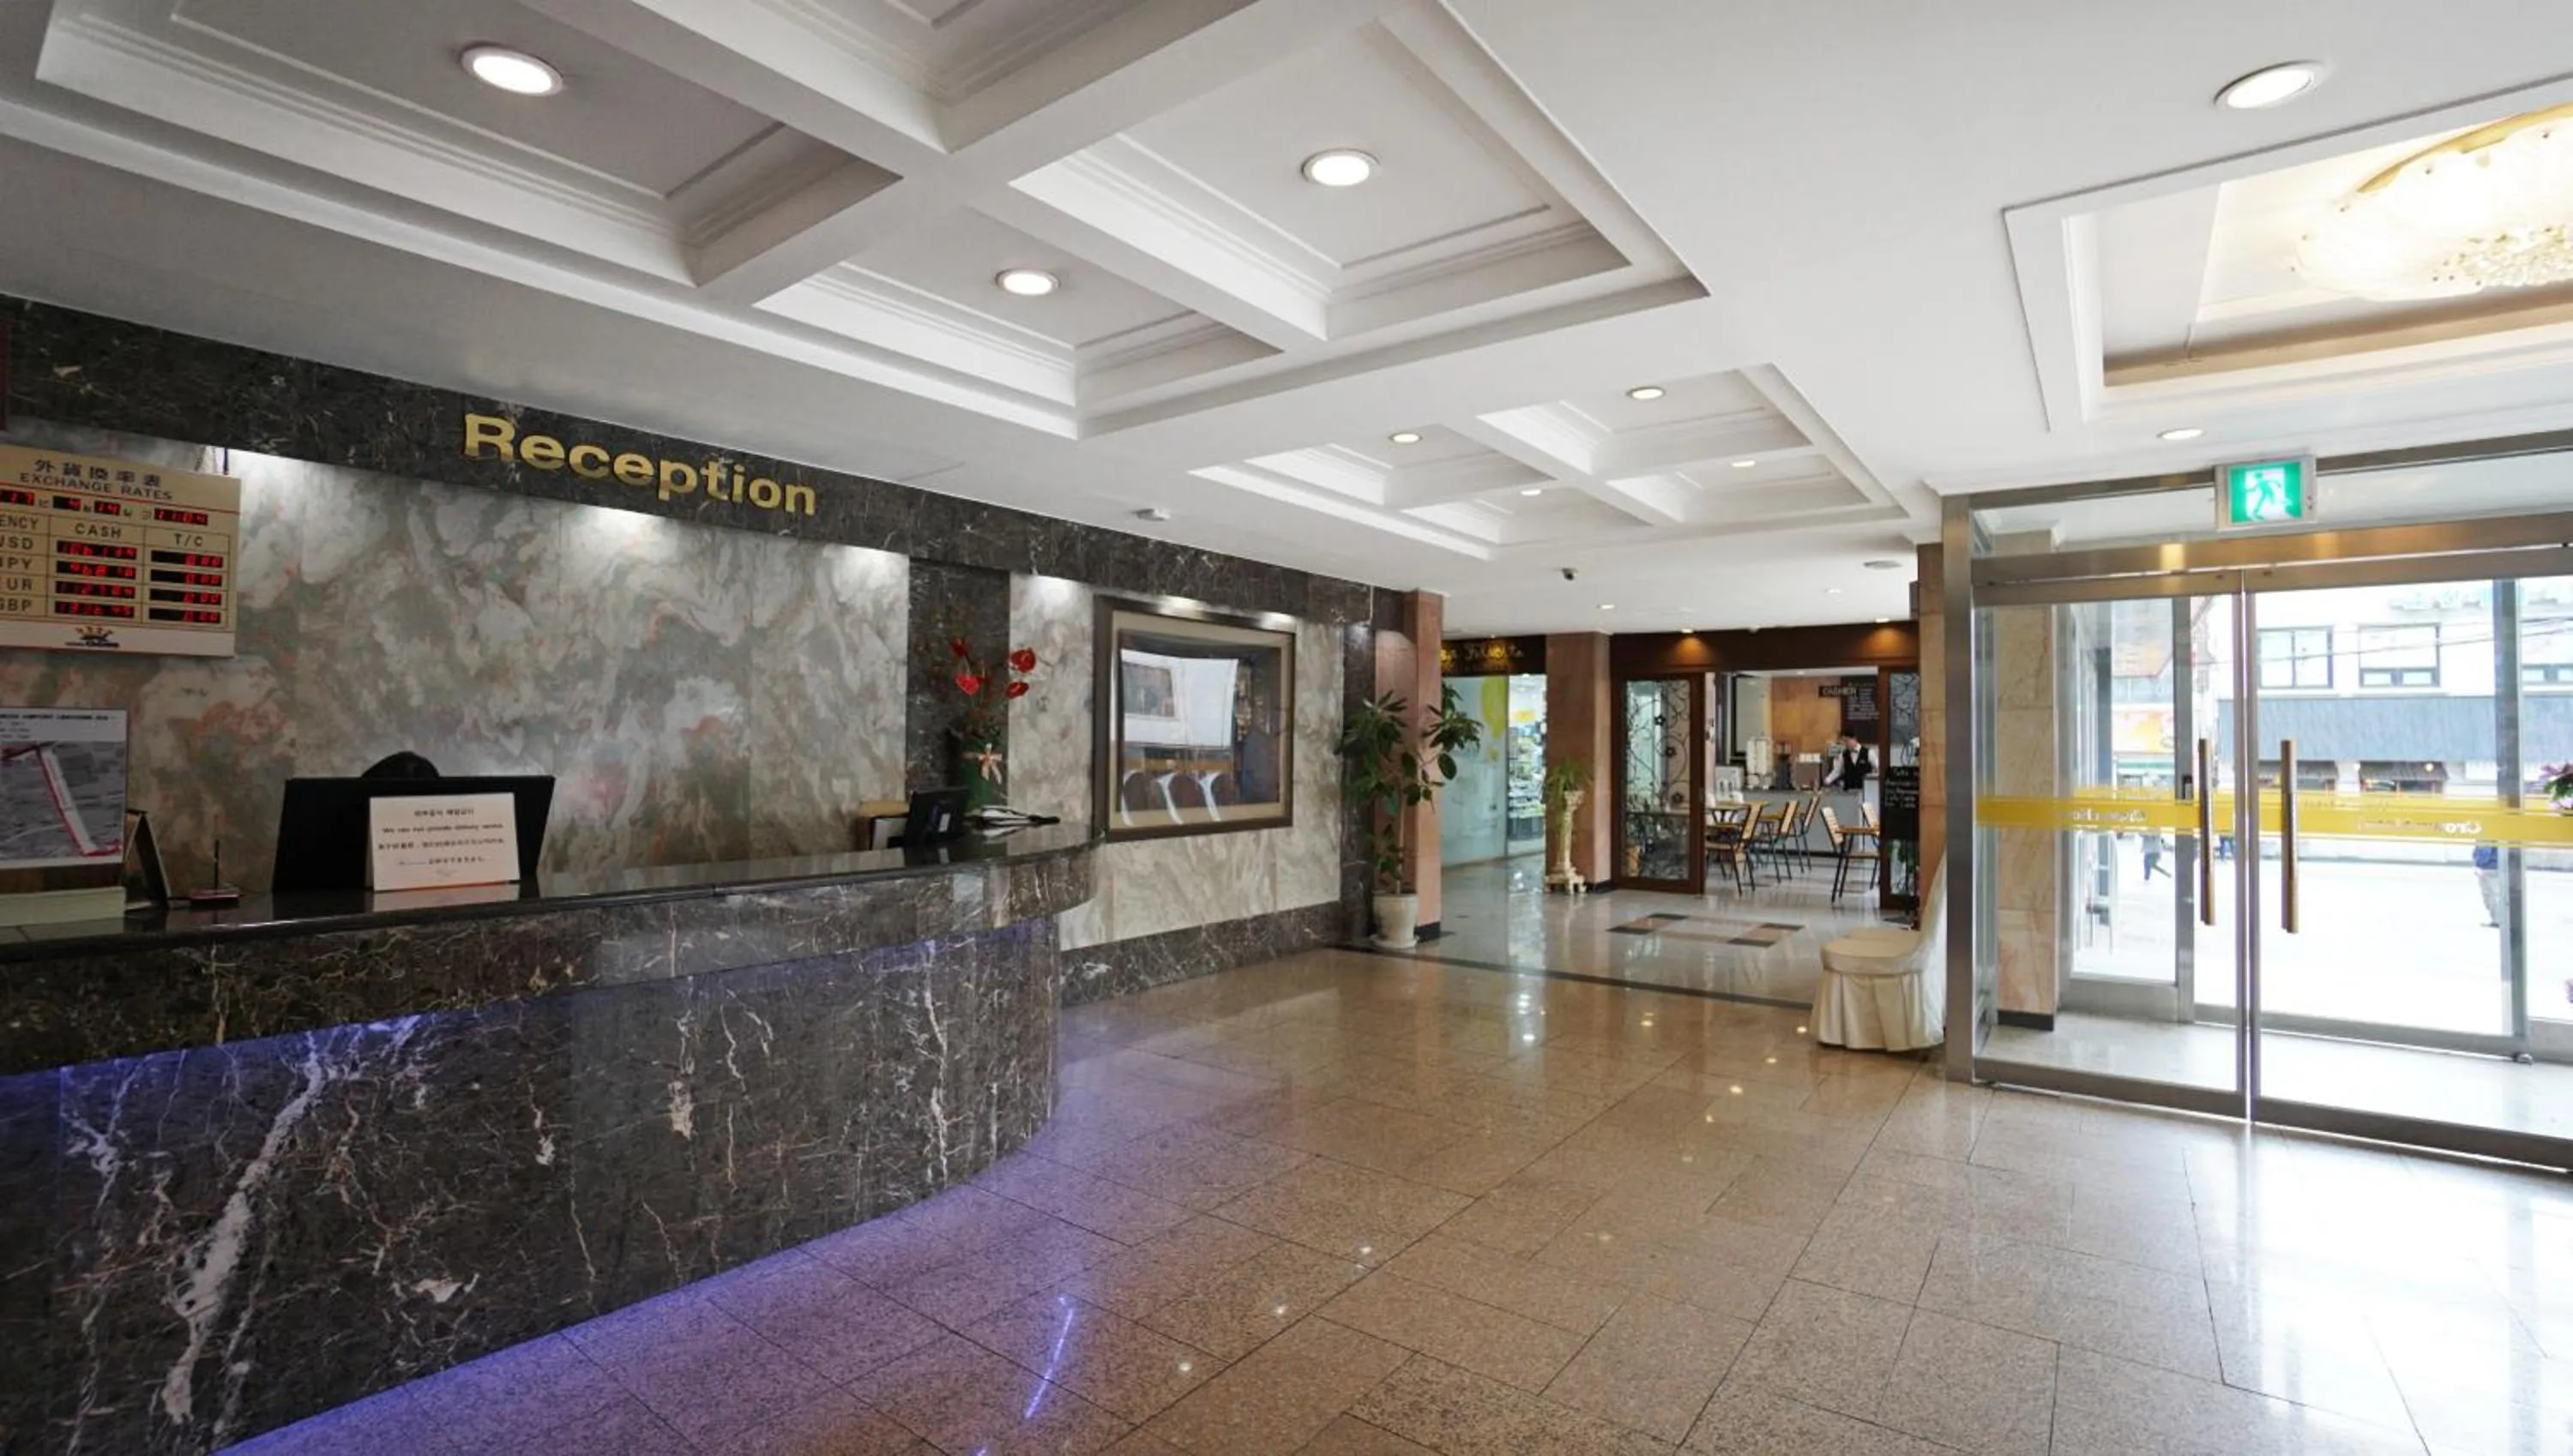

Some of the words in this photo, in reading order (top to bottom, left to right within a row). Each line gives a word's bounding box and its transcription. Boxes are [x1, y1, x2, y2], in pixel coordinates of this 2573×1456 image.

[463, 412, 816, 516] Reception
[20, 472, 112, 494] EXCHANGE
[121, 484, 172, 500] RATES
[75, 522, 122, 538] CASH
[173, 532, 203, 547] T/C
[0, 557, 32, 570] PY
[0, 578, 32, 591] UR
